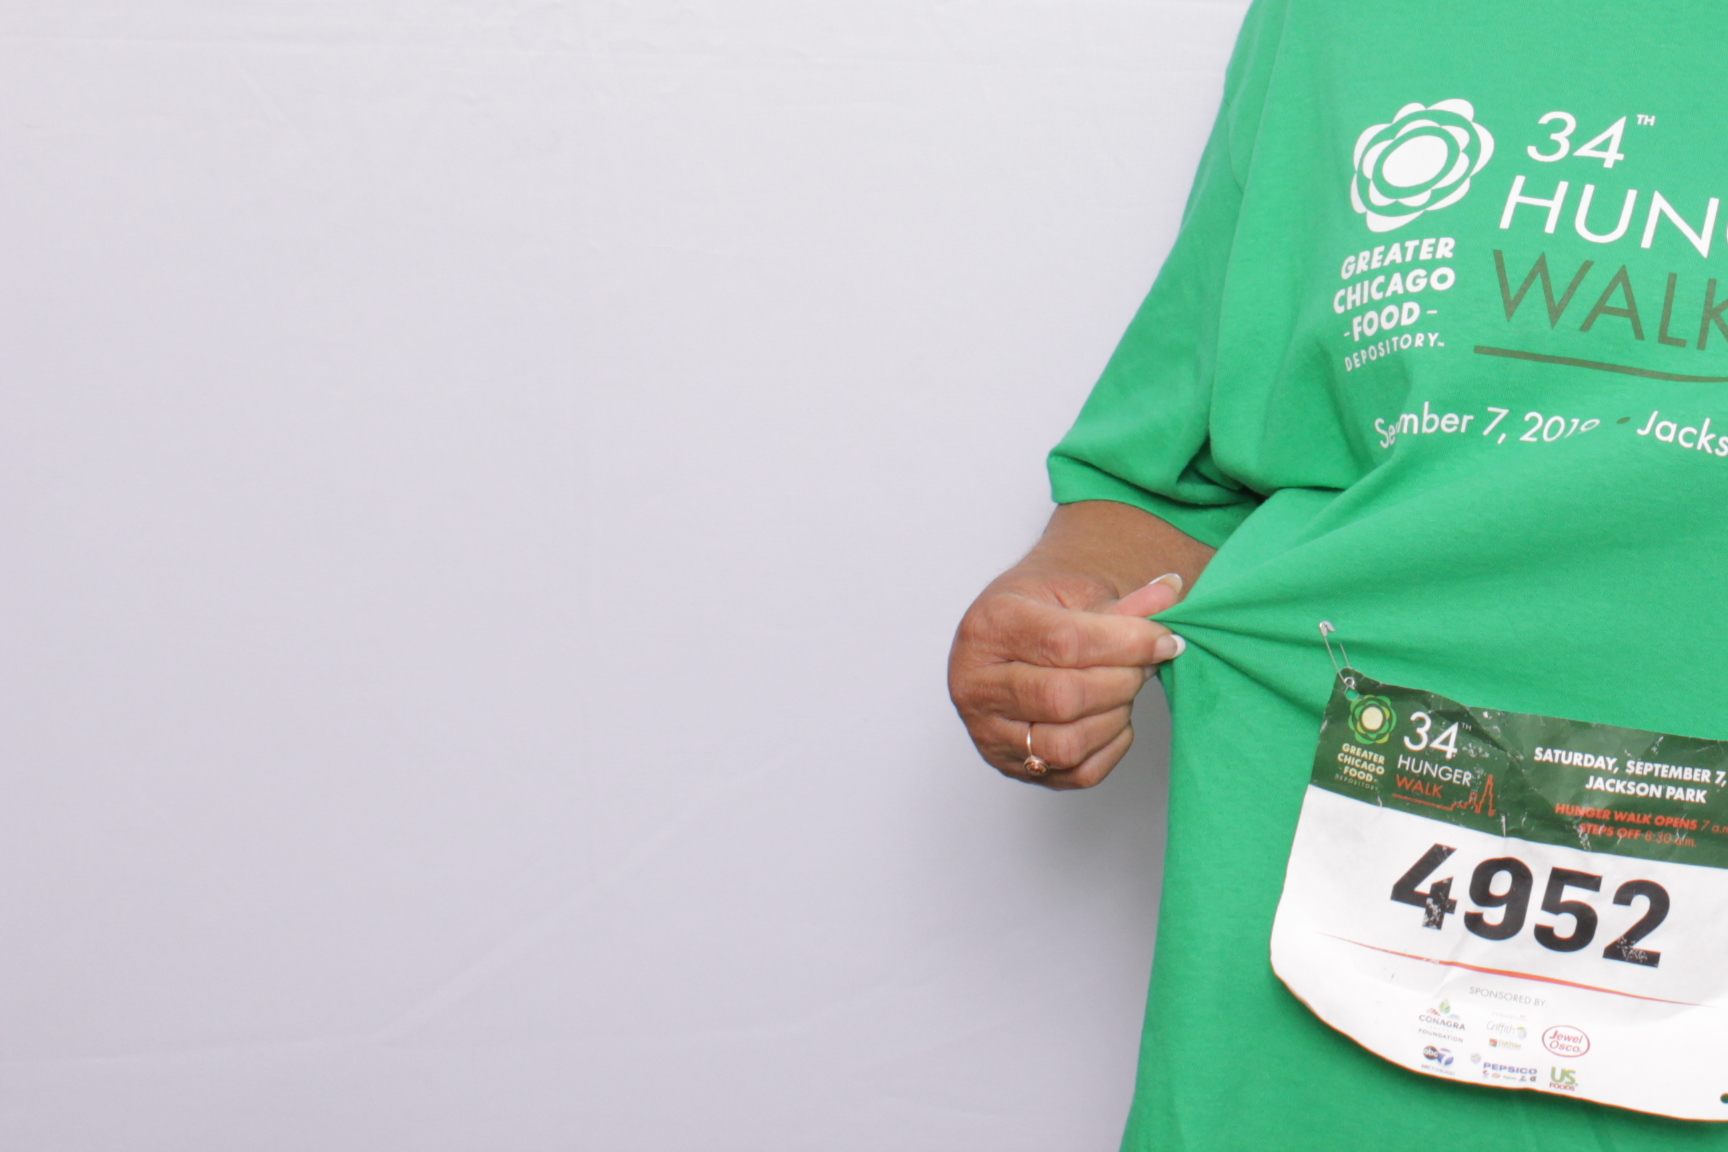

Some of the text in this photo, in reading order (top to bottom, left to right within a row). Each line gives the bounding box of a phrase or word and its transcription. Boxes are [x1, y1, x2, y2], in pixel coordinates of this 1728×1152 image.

[1340, 237, 1456, 280] GREATER
[1333, 266, 1456, 314] CHICAGO
[1483, 406, 1510, 445] 7,
[1337, 752, 1385, 775] CHICAGO
[1342, 742, 1385, 765] GREATER
[1397, 754, 1472, 787] HUNGER
[1533, 747, 1619, 774] SATURDAY,
[1625, 760, 1711, 784] SEPTEMBER
[1714, 770, 1727, 788] 7,
[1395, 774, 1444, 798] WALK
[1585, 776, 1707, 803] JACKSON PARK
[1555, 803, 1611, 821] HUNGER
[1614, 811, 1652, 825] WALK
[1654, 815, 1698, 830] OPENS
[1700, 820, 1711, 831] 7
[1578, 822, 1614, 837] STEPS
[1617, 827, 1642, 840] OFF
[1644, 830, 1672, 844] 8:30
[1390, 843, 1671, 968] 4952
[1469, 986, 1531, 1005] SPONSORED
[1418, 1014, 1466, 1031] CONAGRA
[1549, 1030, 1583, 1044] Jewel
[1483, 1061, 1538, 1076] PEPSICO
